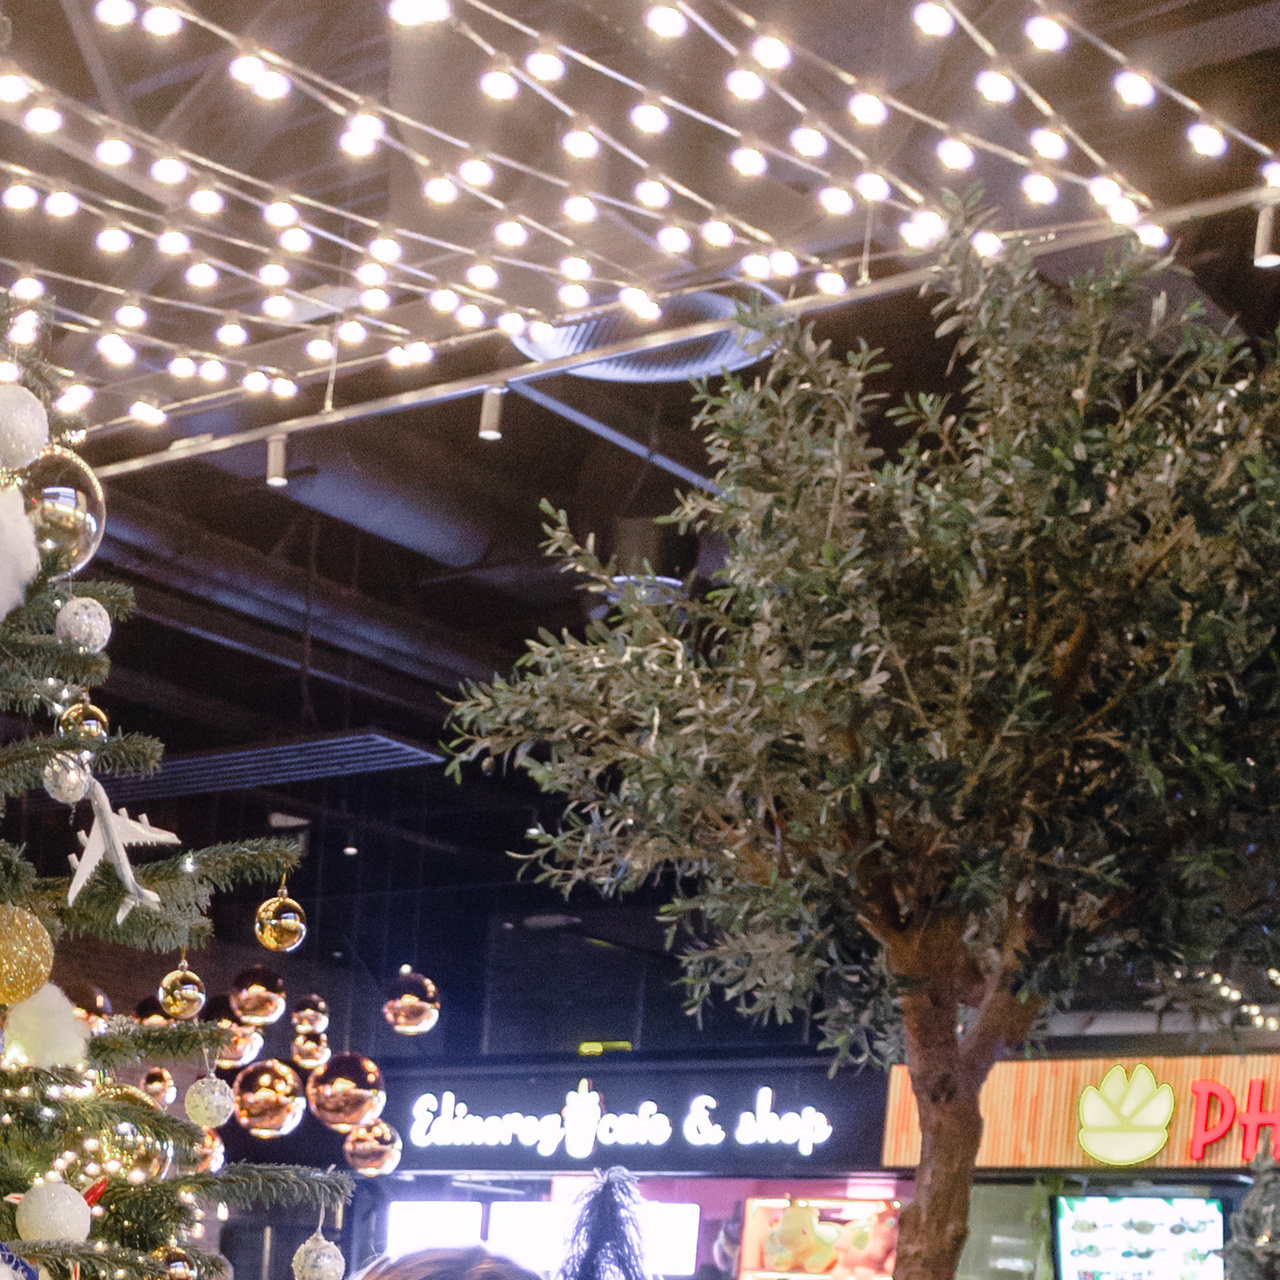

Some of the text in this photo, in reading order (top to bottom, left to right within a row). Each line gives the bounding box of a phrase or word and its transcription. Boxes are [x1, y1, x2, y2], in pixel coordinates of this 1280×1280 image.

[597, 1100, 671, 1145] cafe
[683, 1094, 726, 1146] &
[735, 1086, 832, 1156] shop
